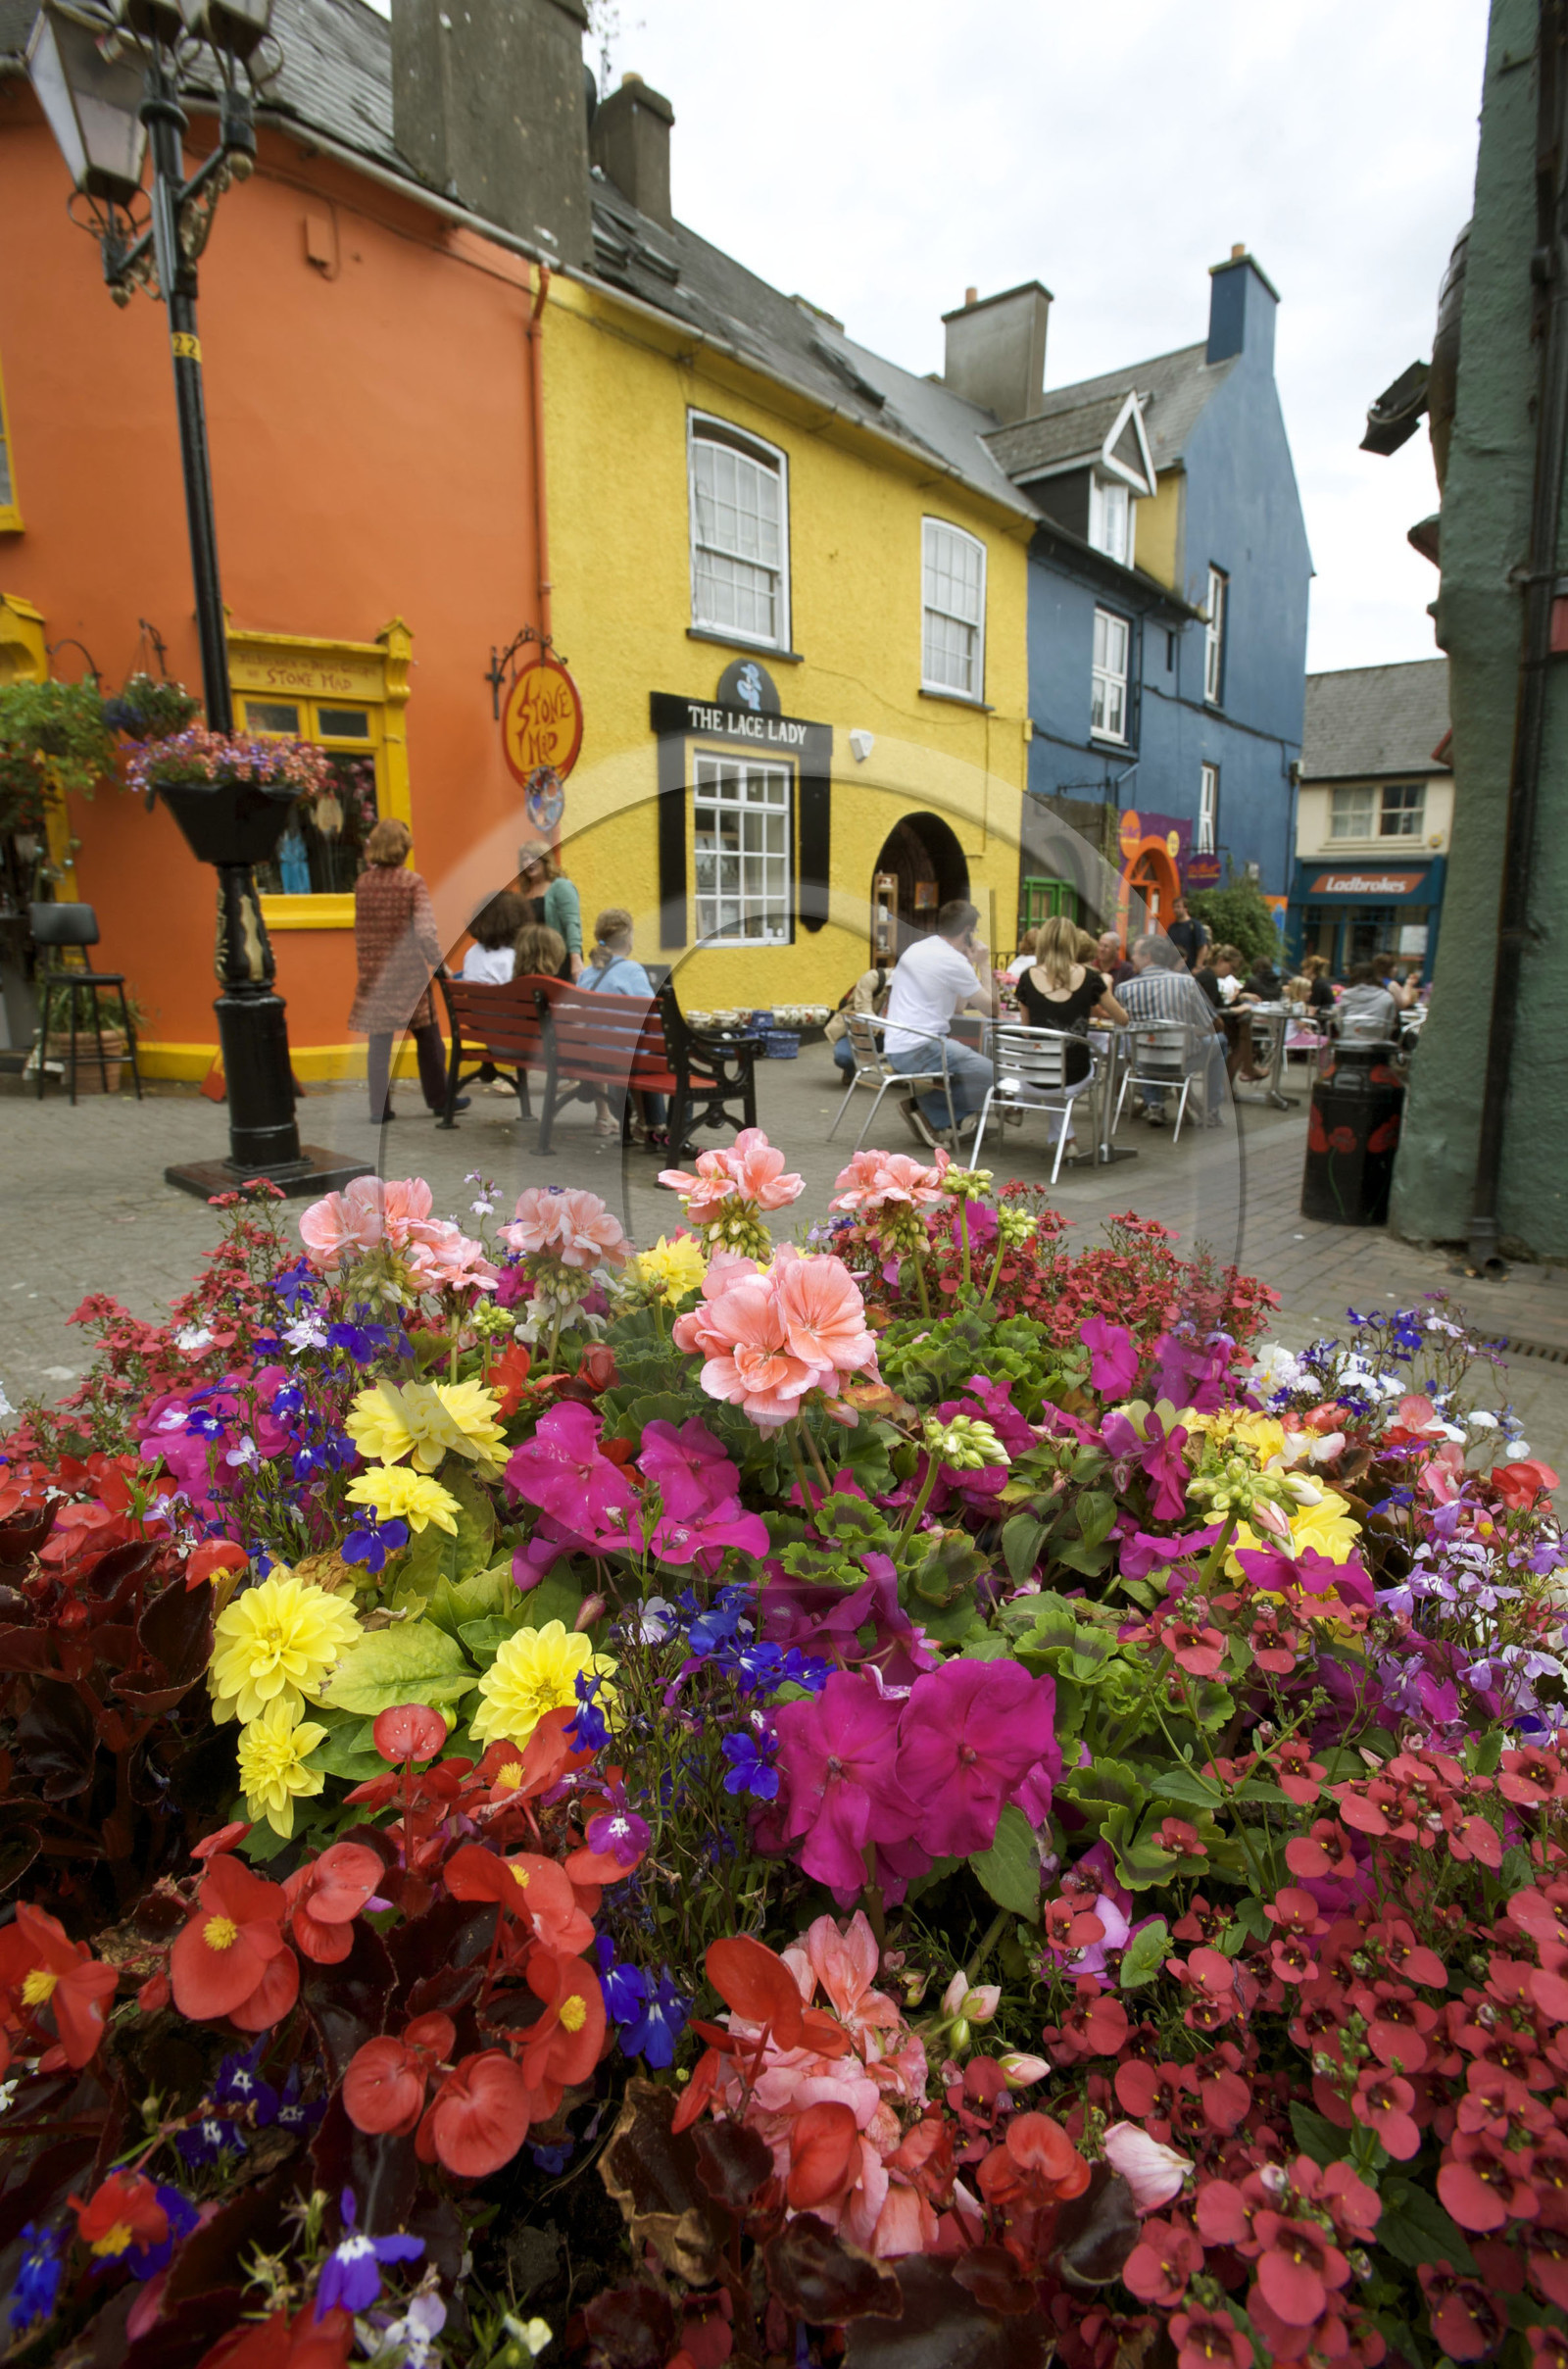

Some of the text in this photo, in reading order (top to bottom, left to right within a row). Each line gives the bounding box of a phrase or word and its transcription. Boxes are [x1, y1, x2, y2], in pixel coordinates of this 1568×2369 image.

[267, 667, 314, 687] STONE
[321, 673, 353, 690] MAD
[516, 675, 572, 732] STONE
[688, 705, 808, 745] THE LACE LADY
[1325, 876, 1405, 893] Ladbrokes
